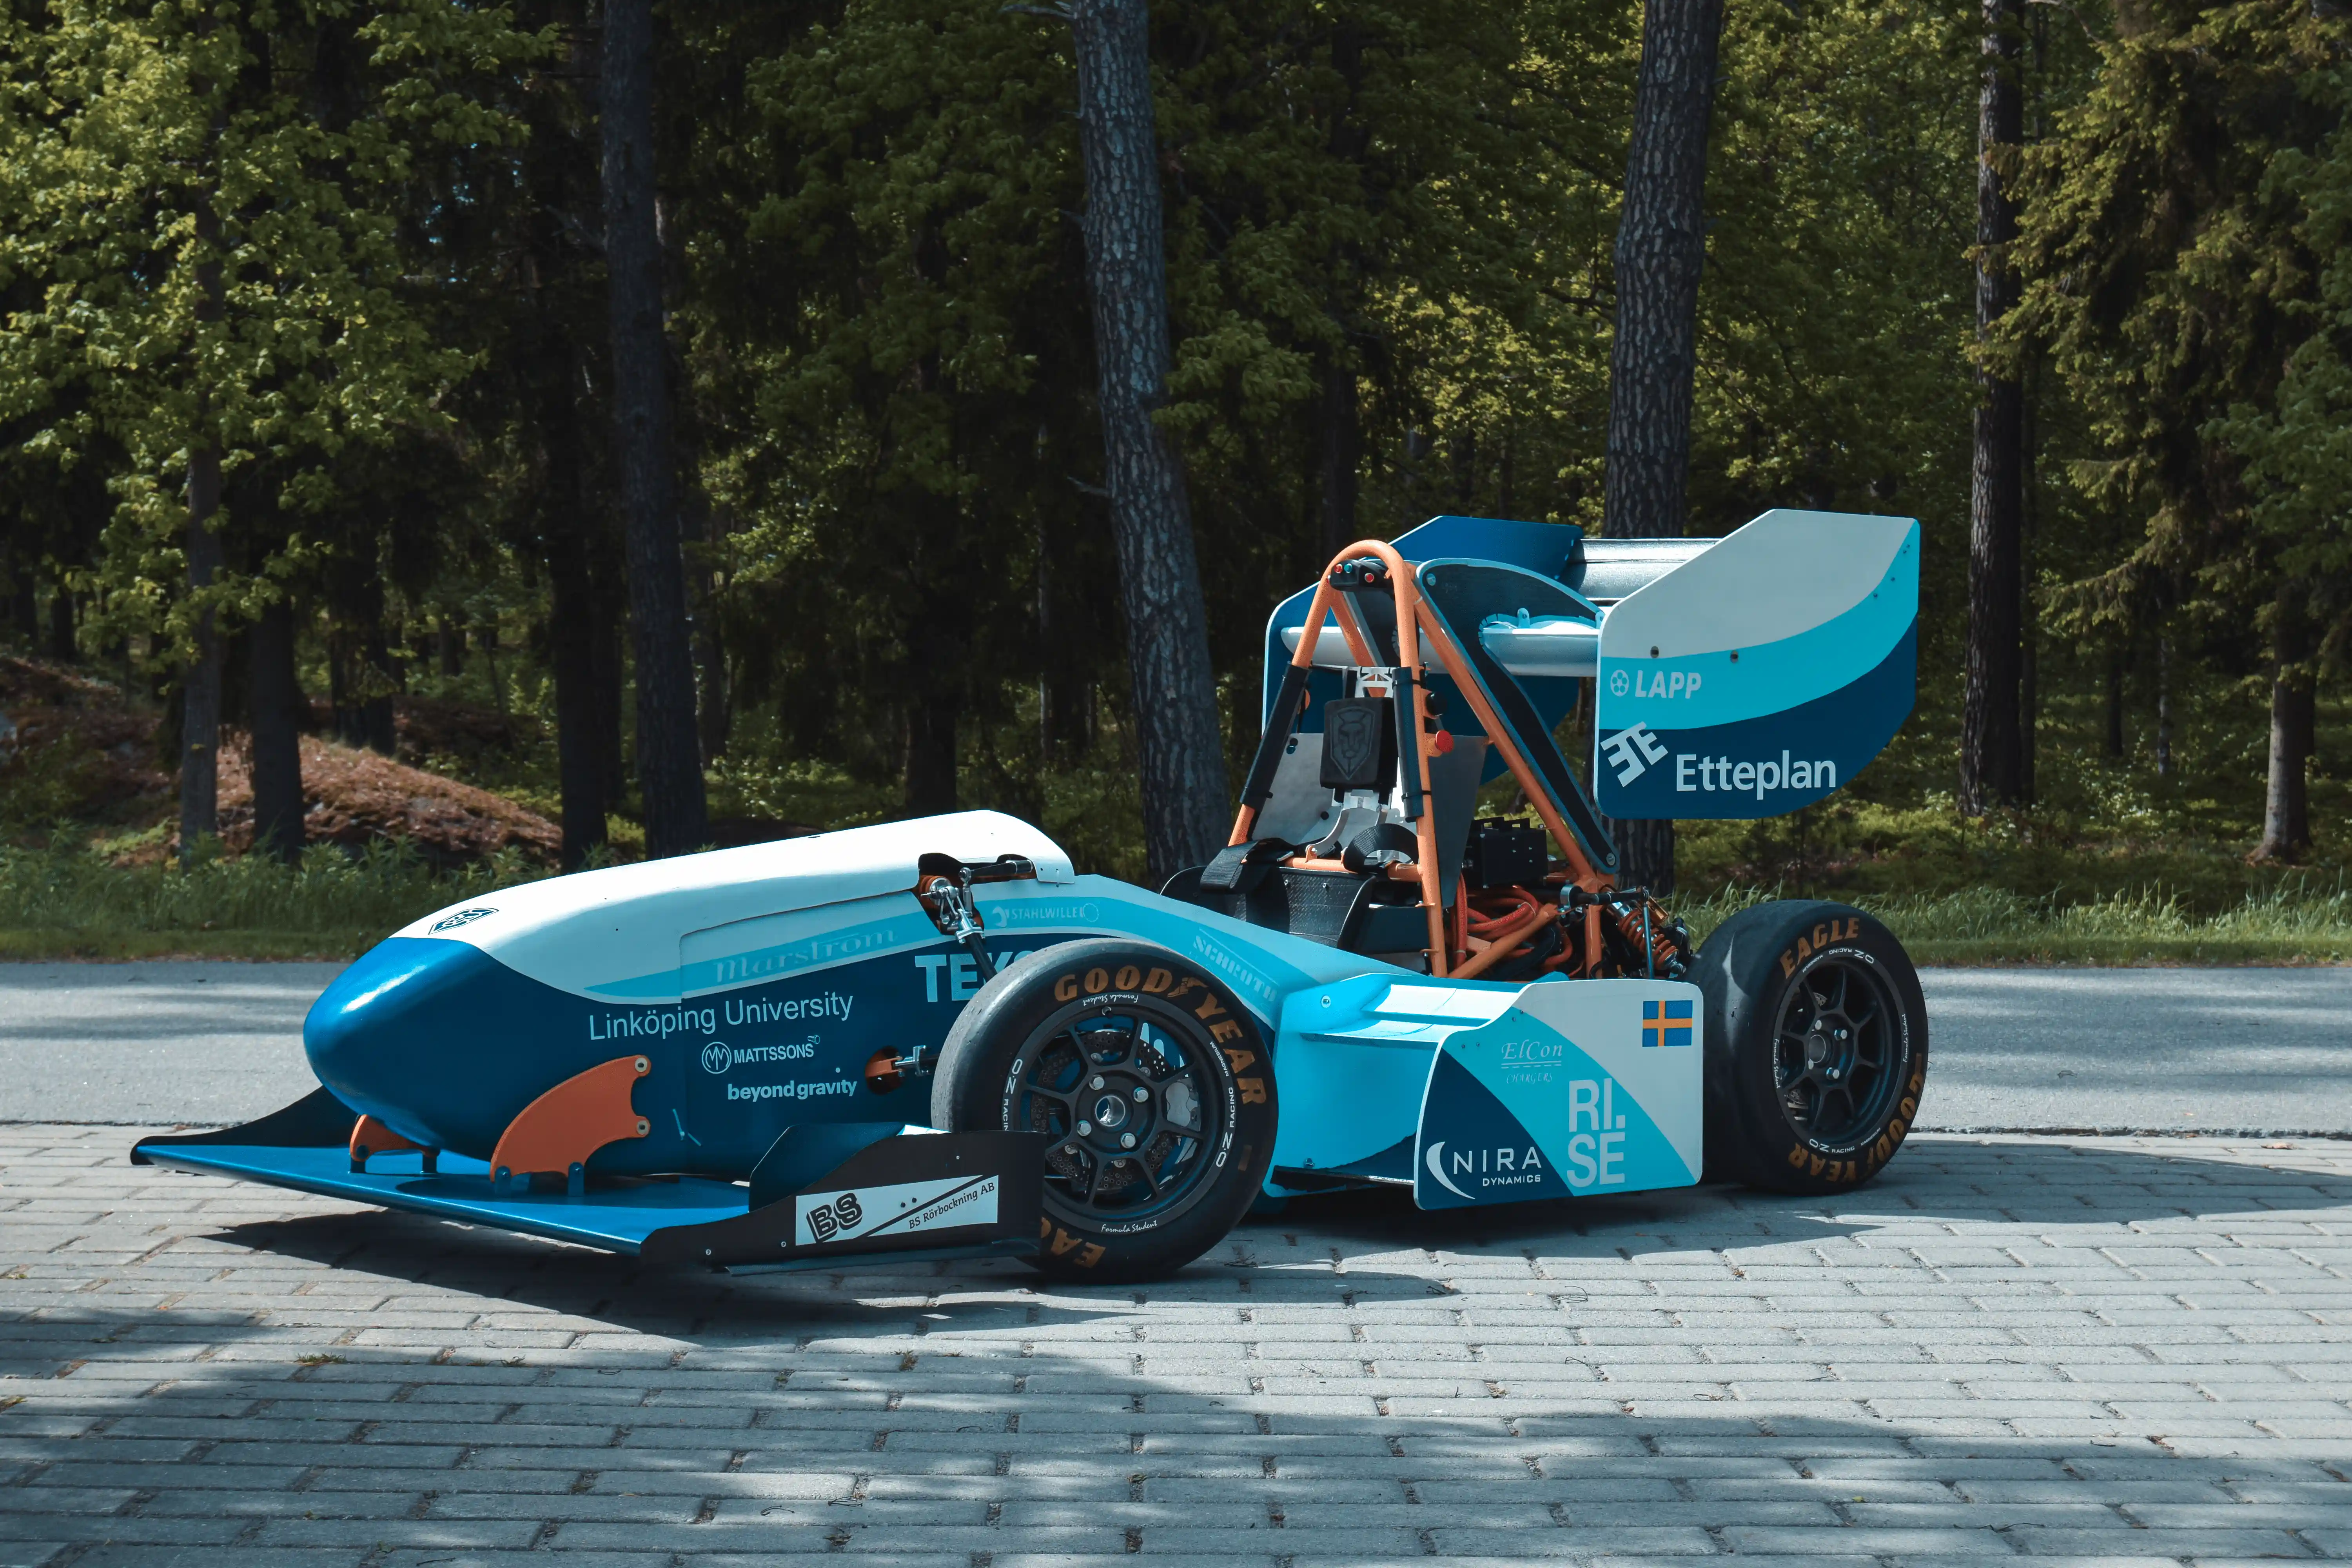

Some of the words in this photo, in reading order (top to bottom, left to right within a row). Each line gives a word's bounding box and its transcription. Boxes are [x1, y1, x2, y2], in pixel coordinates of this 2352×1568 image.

[1635, 670, 1702, 699] LAPP
[1676, 750, 1836, 800] Etteplan
[1009, 907, 1077, 920] STAHLWILLE
[1780, 917, 1860, 979] EAGLE
[1082, 995, 1107, 1007] Student
[1110, 995, 1138, 1003] Formula
[590, 1006, 715, 1040] Linköping
[726, 991, 853, 1025] University
[1054, 965, 1267, 1104] GOODYEAR
[1501, 1039, 1562, 1060] ElCon
[734, 1043, 814, 1063] MATTSSONS
[1210, 1041, 1229, 1077] MAGNESIUM
[728, 1080, 794, 1102] beyond
[797, 1067, 857, 1100] gravity
[1454, 1146, 1542, 1175] NIRA
[1567, 1132, 1625, 1188] SE
[1482, 1174, 1541, 1187] DYNAMICS
[806, 1192, 863, 1243] BS
[909, 1216, 920, 1229] BS
[924, 1191, 978, 1223] Rörbockning
[981, 1182, 995, 1195] AB
[1101, 1224, 1130, 1233] Formula
[1132, 1220, 1158, 1232] Student
